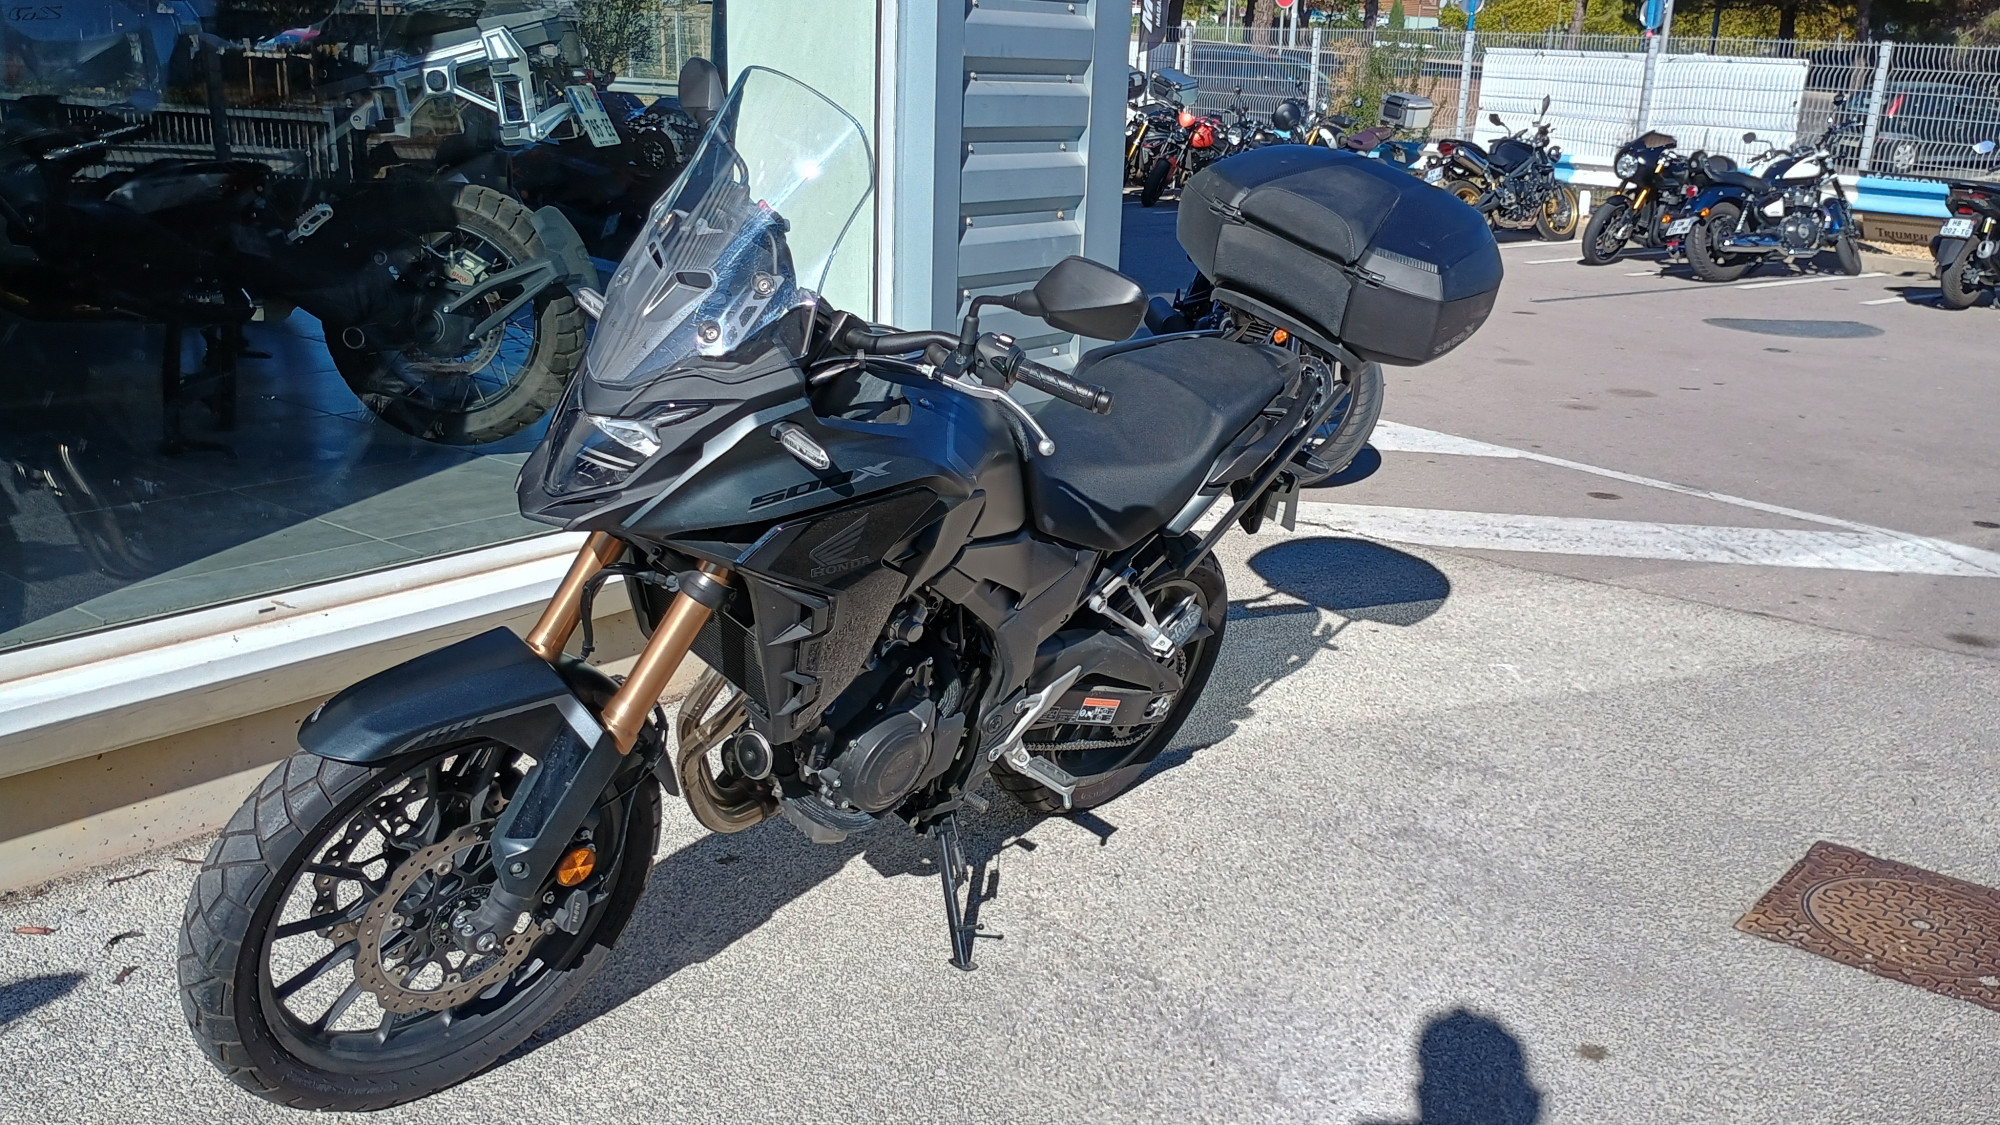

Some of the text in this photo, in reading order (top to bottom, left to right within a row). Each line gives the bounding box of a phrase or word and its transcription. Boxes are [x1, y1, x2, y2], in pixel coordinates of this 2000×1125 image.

[1874, 226, 1929, 243] TRIUMPH
[451, 271, 469, 283] BMW
[810, 555, 872, 578] HONDA
